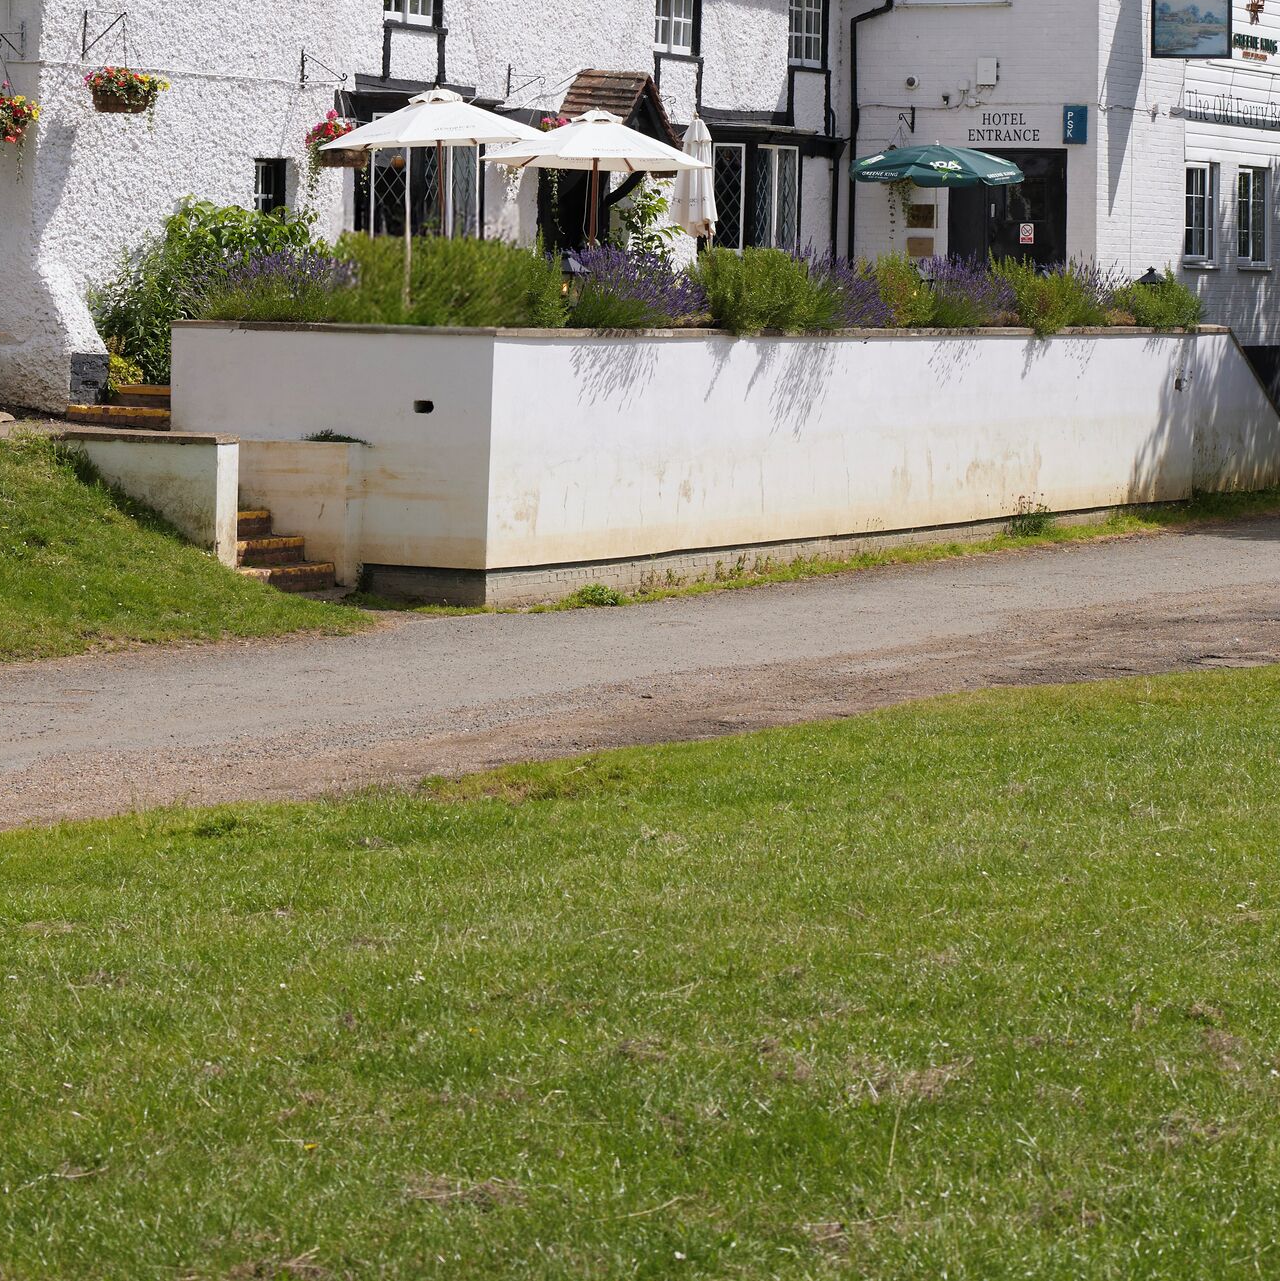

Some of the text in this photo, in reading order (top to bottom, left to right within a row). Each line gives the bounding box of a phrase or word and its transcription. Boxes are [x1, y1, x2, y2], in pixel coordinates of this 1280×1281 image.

[1185, 89, 1209, 120] The
[1213, 94, 1234, 124] Old
[1236, 97, 1267, 129] Ferry
[982, 113, 1026, 125] HOTEL
[968, 129, 1040, 142] ENTRANCE
